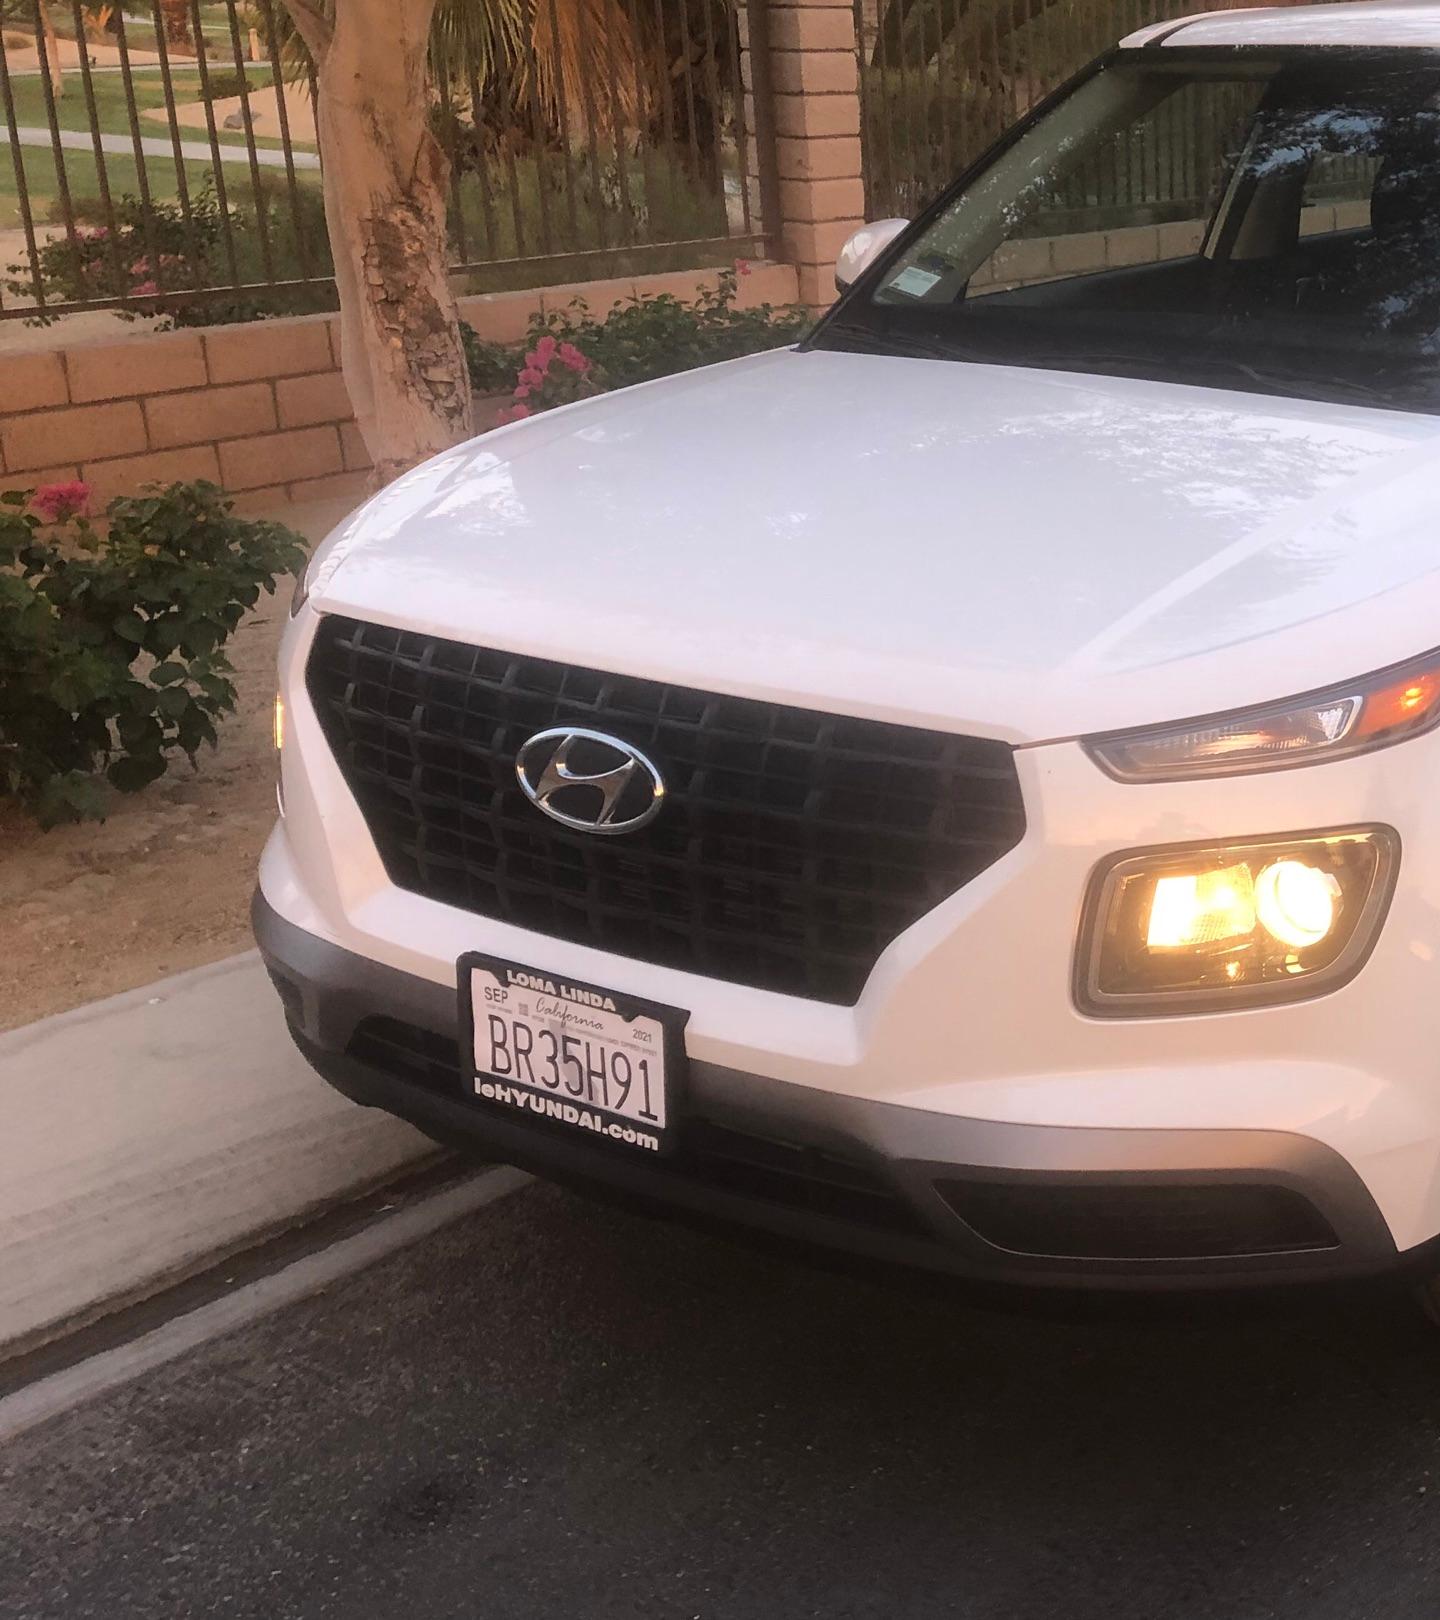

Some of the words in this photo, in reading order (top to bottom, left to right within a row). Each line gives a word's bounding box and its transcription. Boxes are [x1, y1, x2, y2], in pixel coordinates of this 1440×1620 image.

[484, 986, 508, 1004] SEP
[506, 969, 556, 995] LOMA
[560, 984, 616, 1012] LINDA
[536, 996, 604, 1030] California
[632, 1028, 652, 1044] 2021
[487, 1013, 658, 1122] BR35H91
